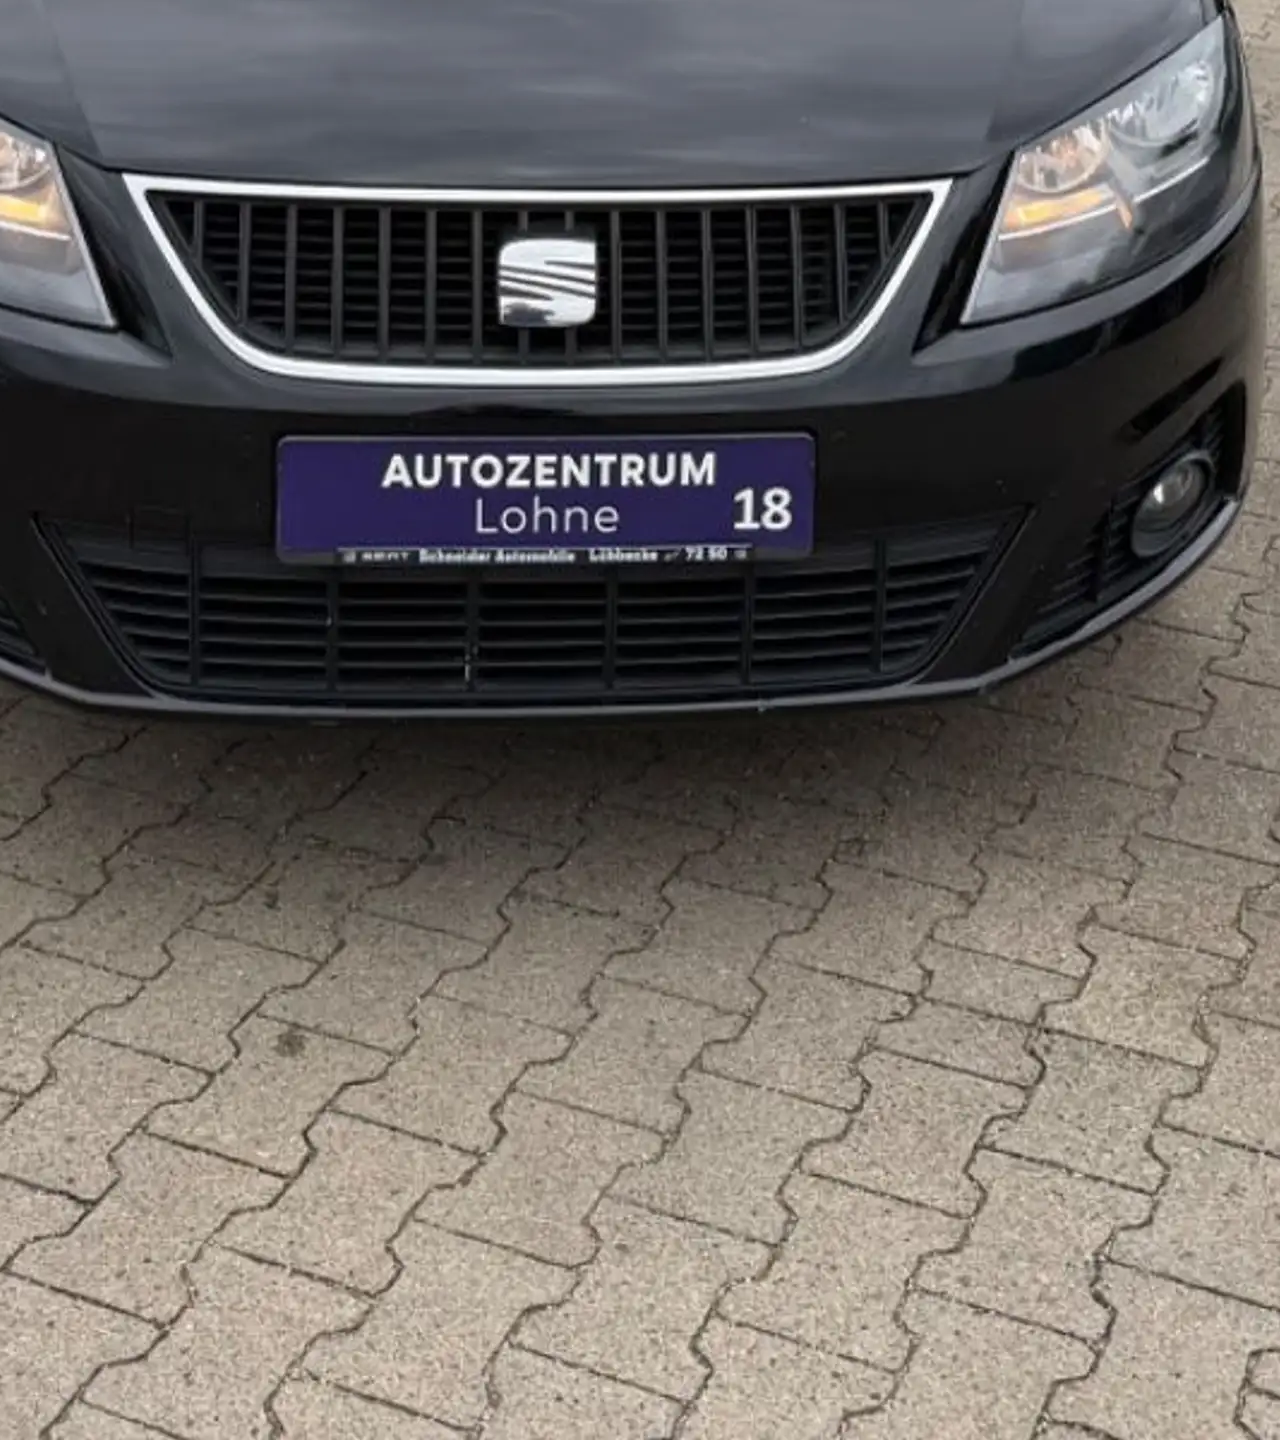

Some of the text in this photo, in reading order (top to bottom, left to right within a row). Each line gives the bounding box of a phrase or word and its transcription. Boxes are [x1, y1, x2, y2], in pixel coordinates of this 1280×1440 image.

[380, 452, 717, 489] AUTOZENTRUM
[475, 497, 620, 536] Lohne
[733, 488, 793, 532] 18
